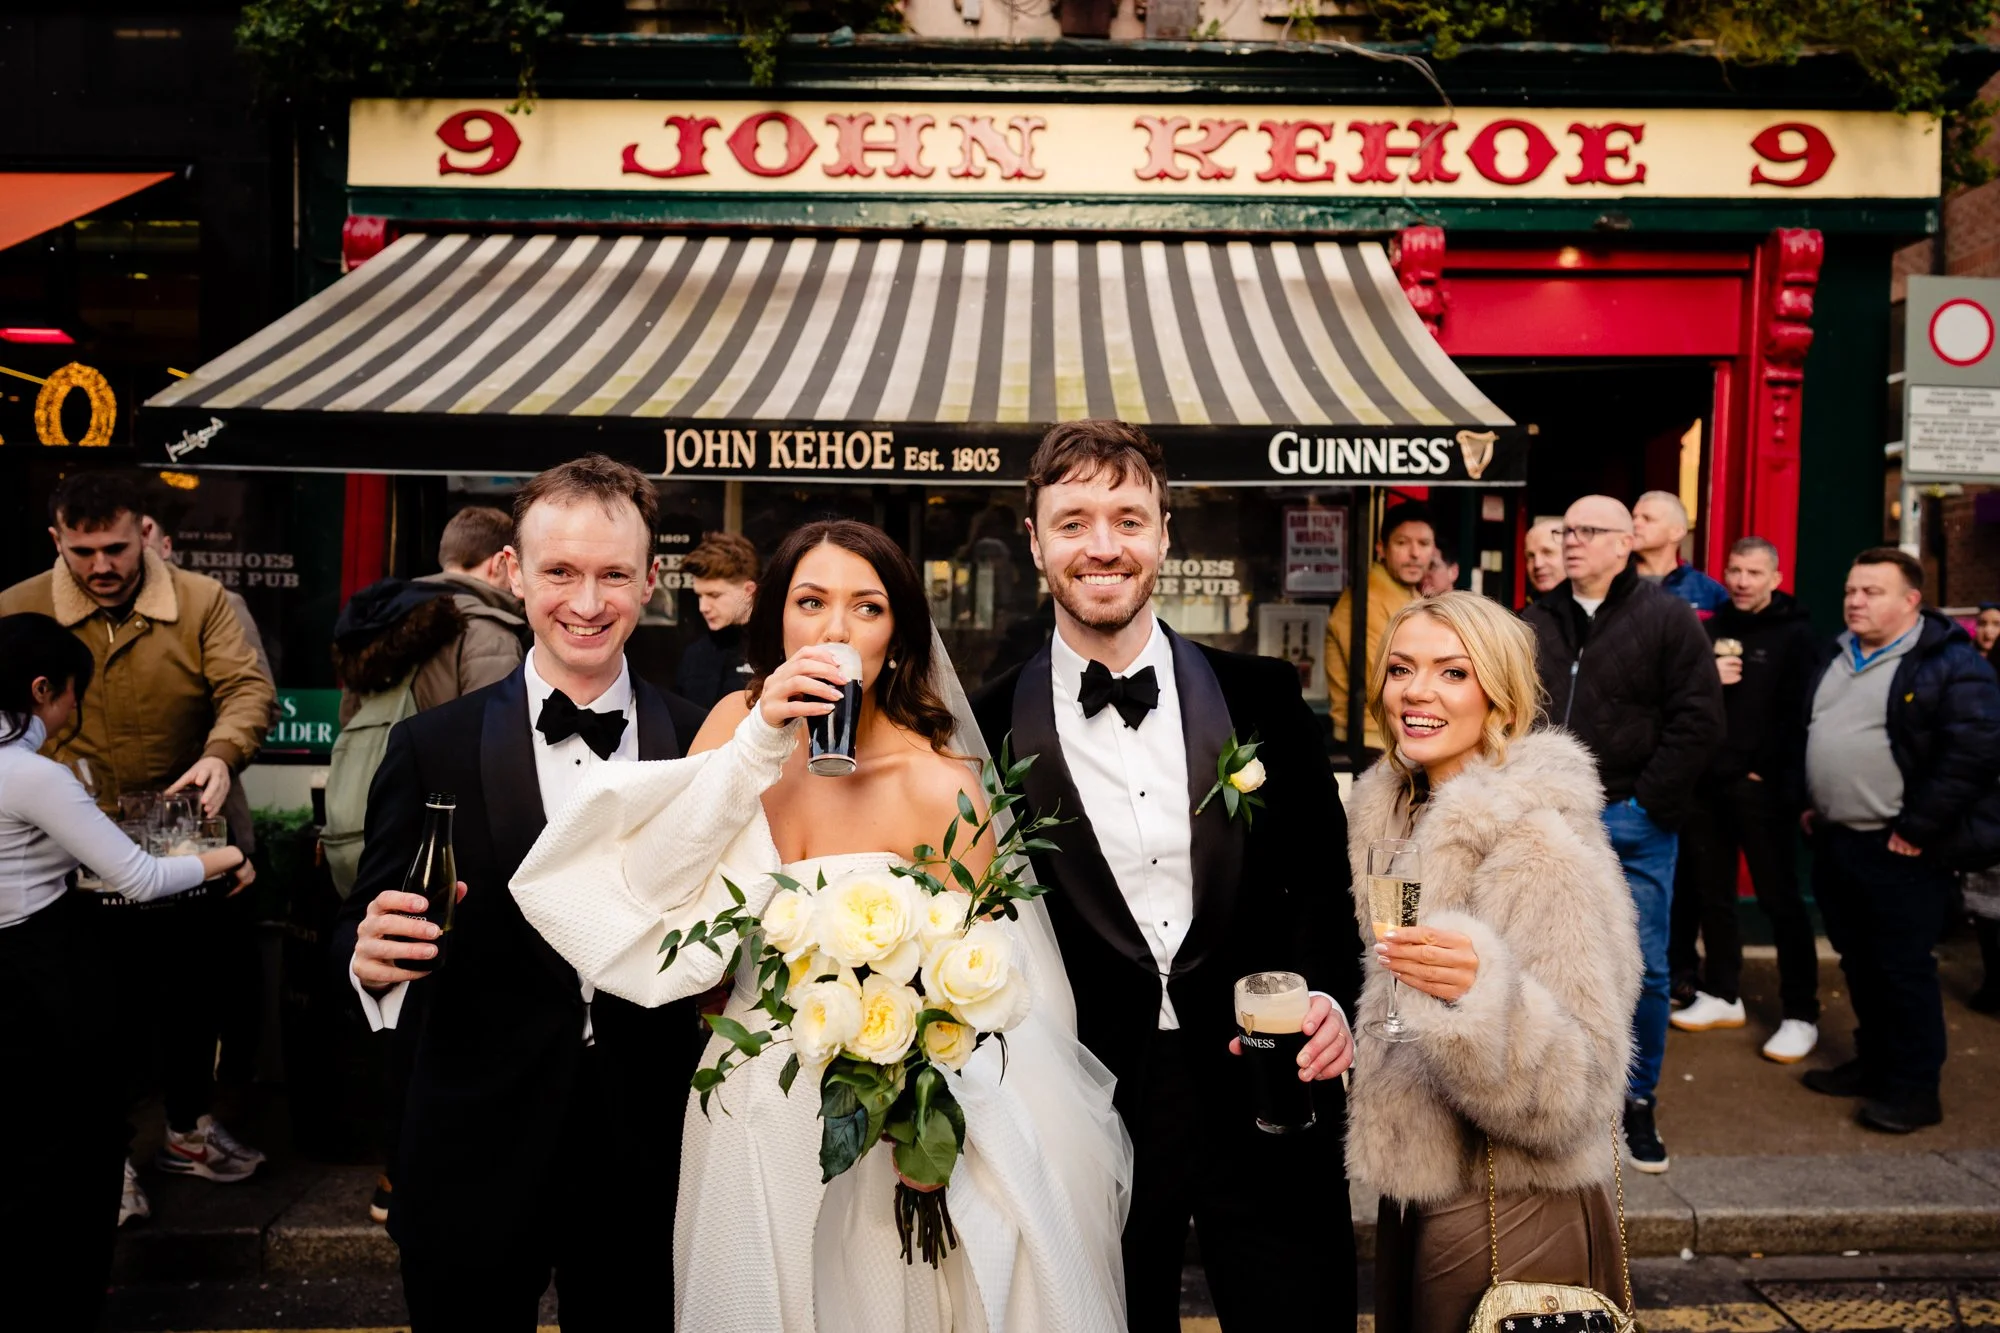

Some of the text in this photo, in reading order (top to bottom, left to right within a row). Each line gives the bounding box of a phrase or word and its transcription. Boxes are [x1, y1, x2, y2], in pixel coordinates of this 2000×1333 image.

[436, 109, 1836, 187] 9 JOHN KEHOE 9
[663, 429, 1001, 476] JOHN KEHOE Est. 1803
[1268, 431, 1451, 475] GUINNESS
[191, 551, 294, 569] KEHOES
[247, 572, 299, 588] PUB
[1183, 578, 1240, 596] PUB
